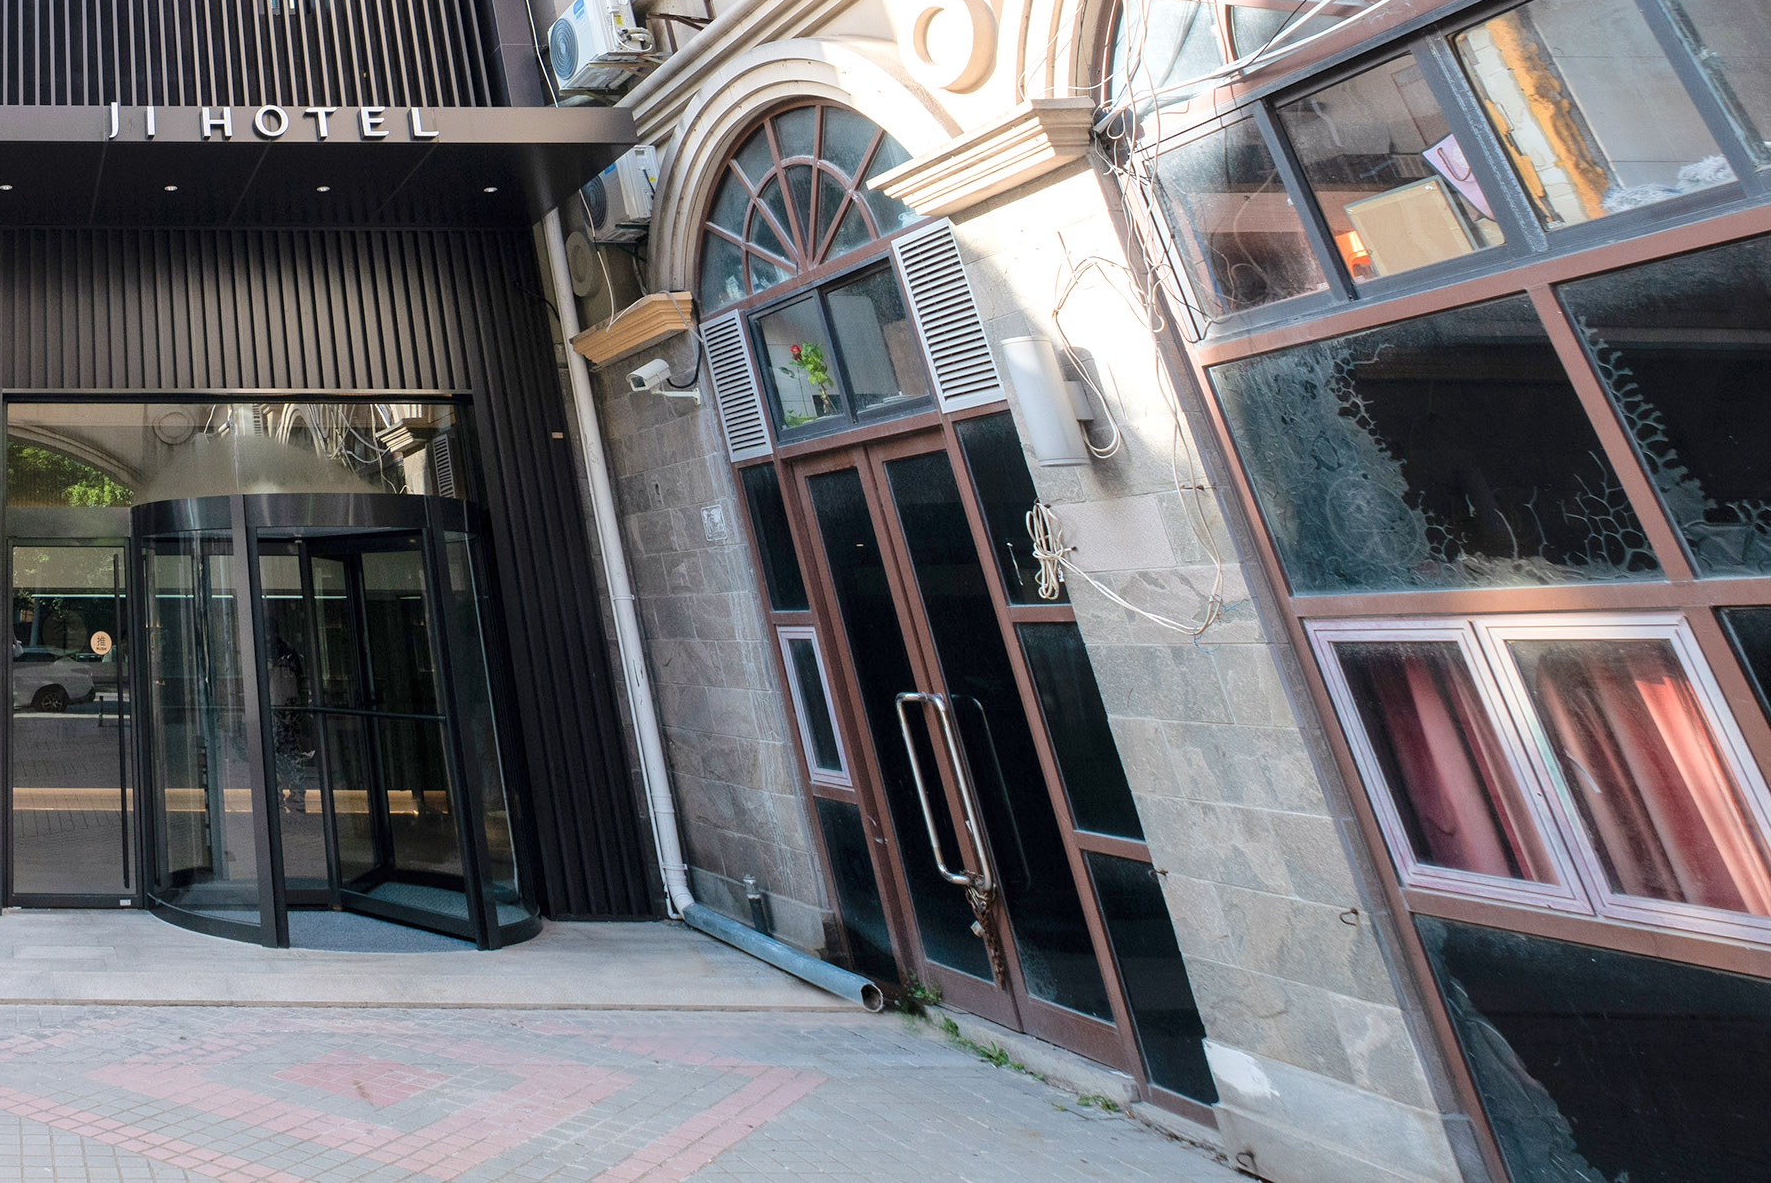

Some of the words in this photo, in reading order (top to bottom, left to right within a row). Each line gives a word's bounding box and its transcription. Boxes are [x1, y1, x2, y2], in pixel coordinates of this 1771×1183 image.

[109, 101, 156, 139] JI
[201, 104, 440, 140] HOTEL
[97, 636, 107, 646] 推
